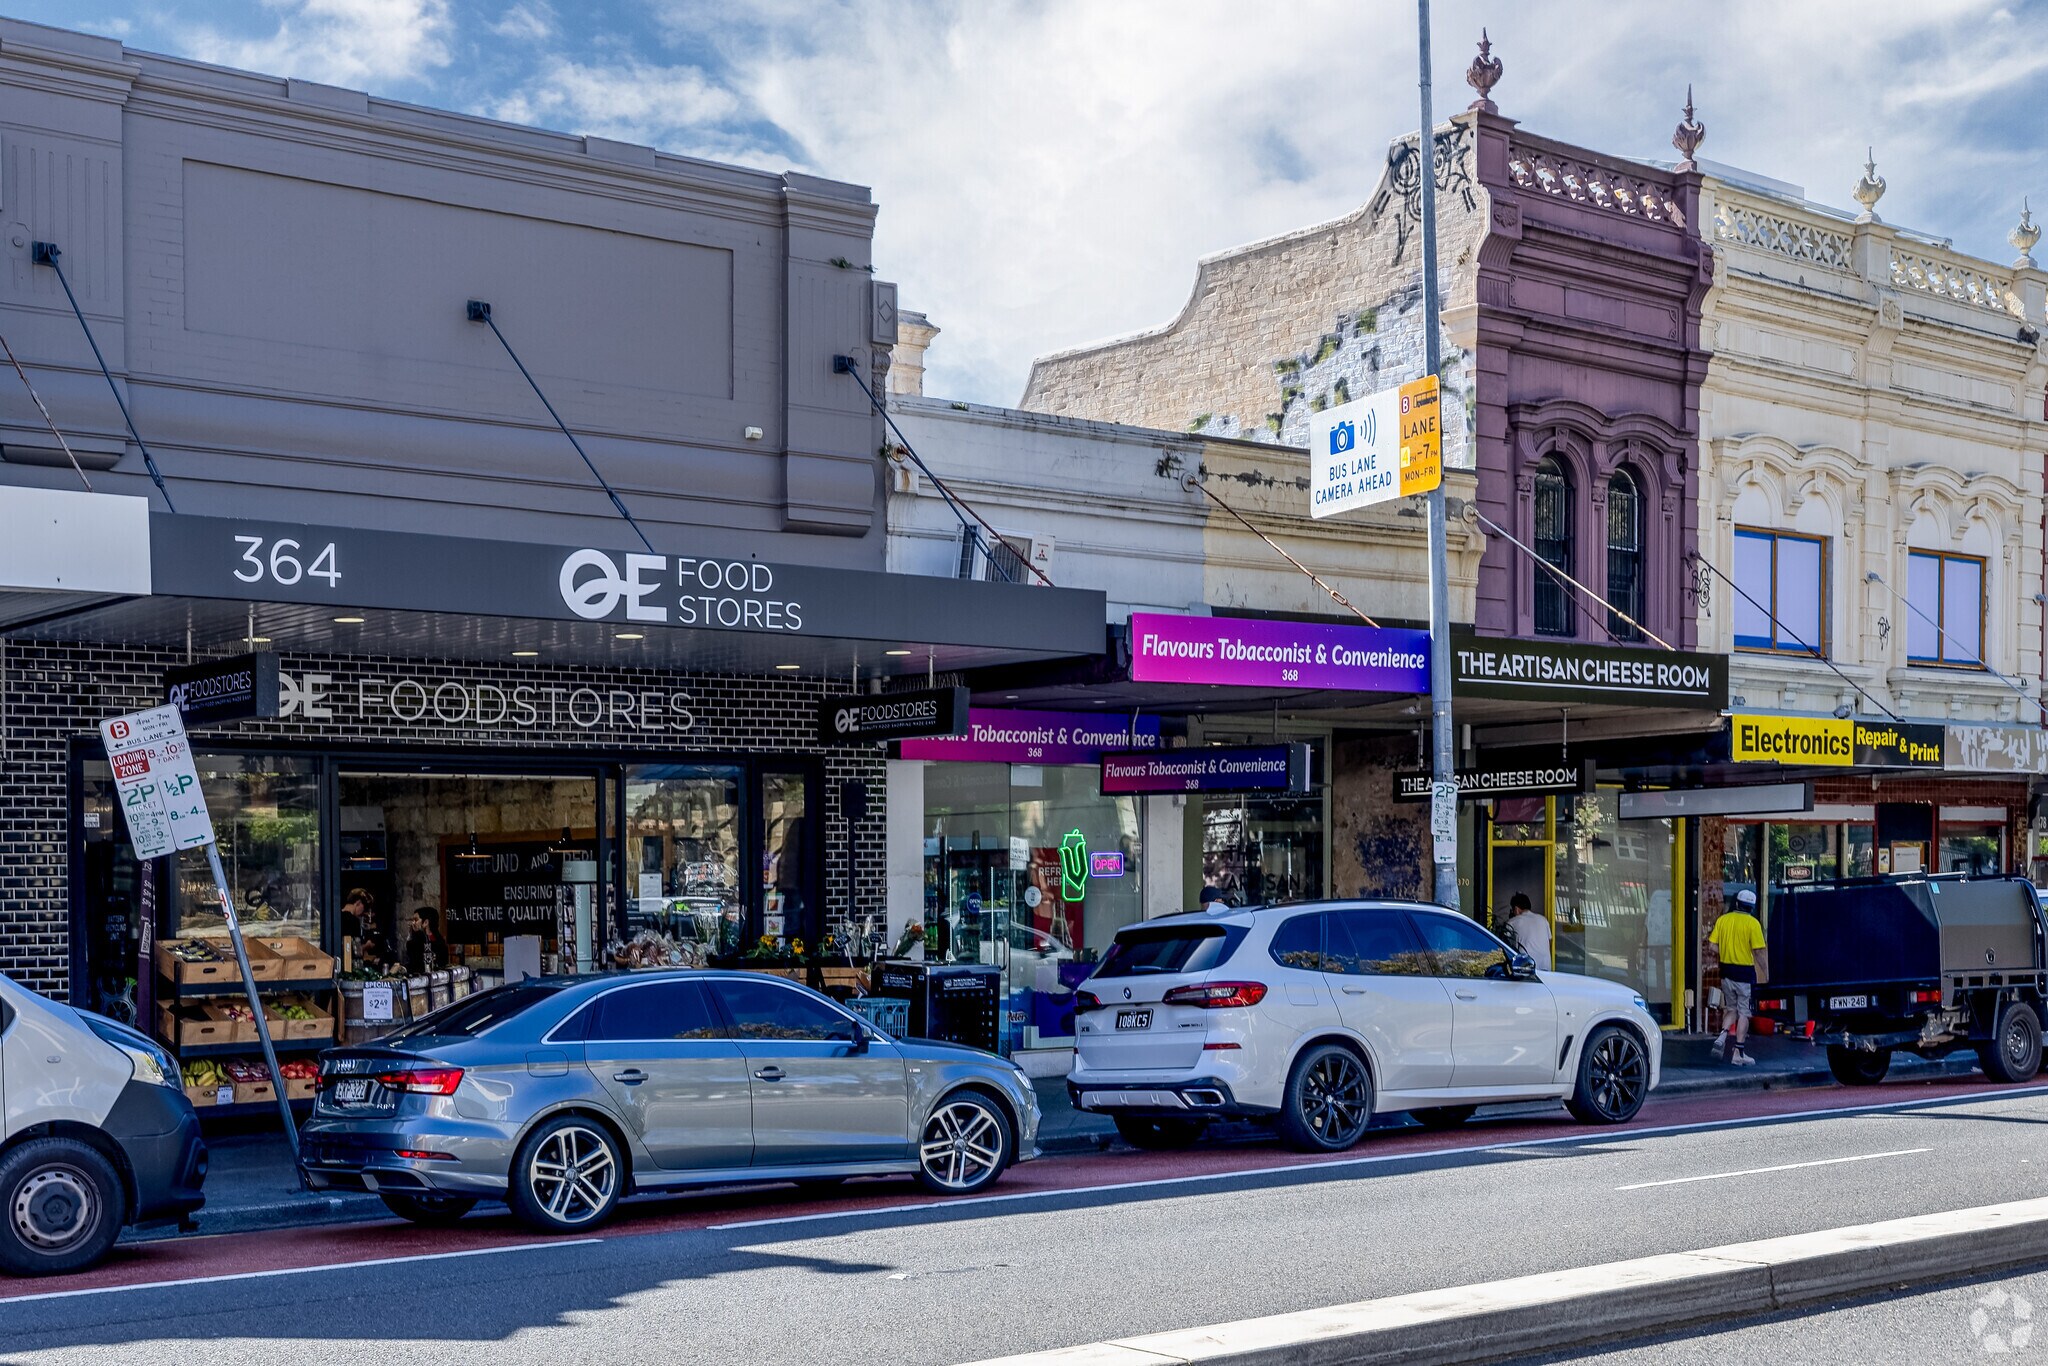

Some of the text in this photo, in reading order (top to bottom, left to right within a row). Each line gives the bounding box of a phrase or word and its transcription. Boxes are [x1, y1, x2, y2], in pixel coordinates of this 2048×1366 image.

[1402, 396, 1410, 415] B
[1404, 417, 1436, 439] LANE
[1329, 454, 1376, 481] BUS LANE
[1315, 471, 1392, 504] CAMERA AHEAD
[233, 535, 342, 588] 364
[678, 557, 773, 592] FOOD
[679, 595, 802, 630] STORES
[1142, 634, 1425, 669] Flavours Tobacconist & Convenience
[1282, 669, 1298, 682] 368
[1458, 651, 1709, 688] THE ARTISAN CHEESE ROOM
[190, 671, 251, 698] FOODSTORES
[358, 678, 694, 730] FOODSTORES
[861, 700, 937, 721] FOODSTORES
[114, 720, 127, 739] B
[126, 732, 163, 746] BUS LANE
[972, 724, 1053, 745] Tobacconist
[1057, 728, 1068, 745] &
[1028, 748, 1043, 758] 368
[1741, 724, 1851, 755] Electronics
[1856, 726, 1898, 747] Repair
[1900, 737, 1908, 754] &
[1909, 743, 1940, 762] Print
[112, 749, 146, 767] LOADING
[163, 755, 181, 763] DAYS
[1106, 757, 1286, 778] Flavours Tobacconist & Convenience
[120, 763, 145, 777] ZONE
[1401, 768, 1577, 792] THE ASAN CHEESE ROOM
[1185, 779, 1199, 790] 368
[1435, 785, 1455, 798] 2P
[127, 784, 155, 807] 2P
[132, 801, 157, 812] TICKET
[468, 853, 519, 874] REFUND
[530, 852, 550, 870] AND
[1094, 858, 1121, 871] OPEN
[504, 885, 553, 901] ENSURING
[508, 905, 553, 923] QUALITY
[365, 981, 391, 989] SPECIAL
[1118, 1013, 1149, 1029] 108KC5
